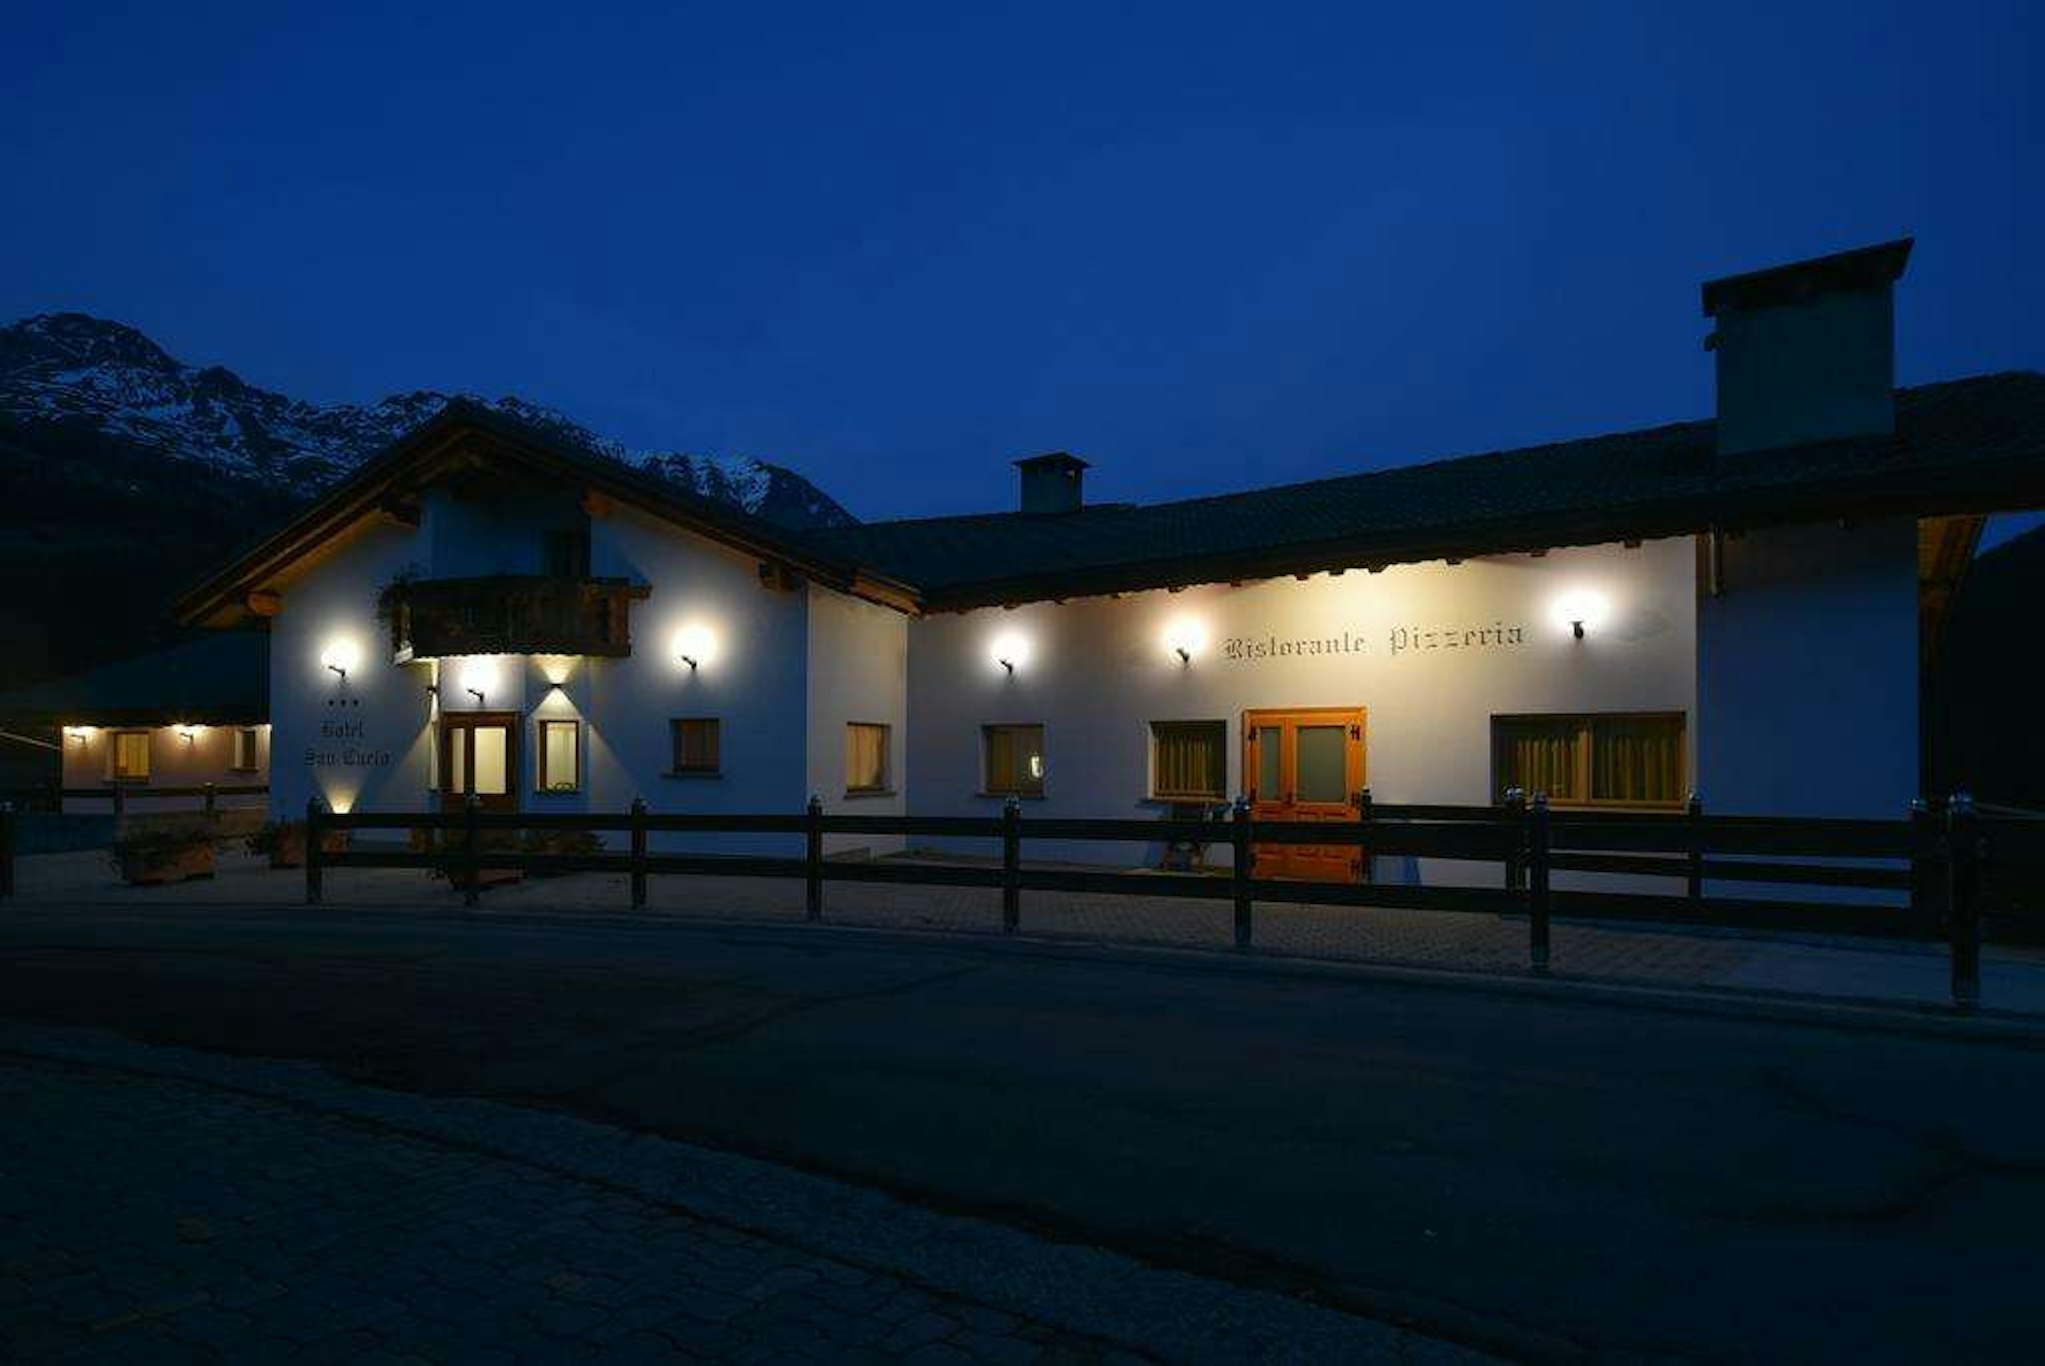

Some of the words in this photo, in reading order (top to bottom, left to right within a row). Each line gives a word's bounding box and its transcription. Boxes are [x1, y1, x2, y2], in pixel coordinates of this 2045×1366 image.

[1225, 631, 1366, 659] Ristorante
[1390, 621, 1522, 655] Pizzeria
[320, 720, 364, 738] Hotel
[304, 748, 336, 766] San
